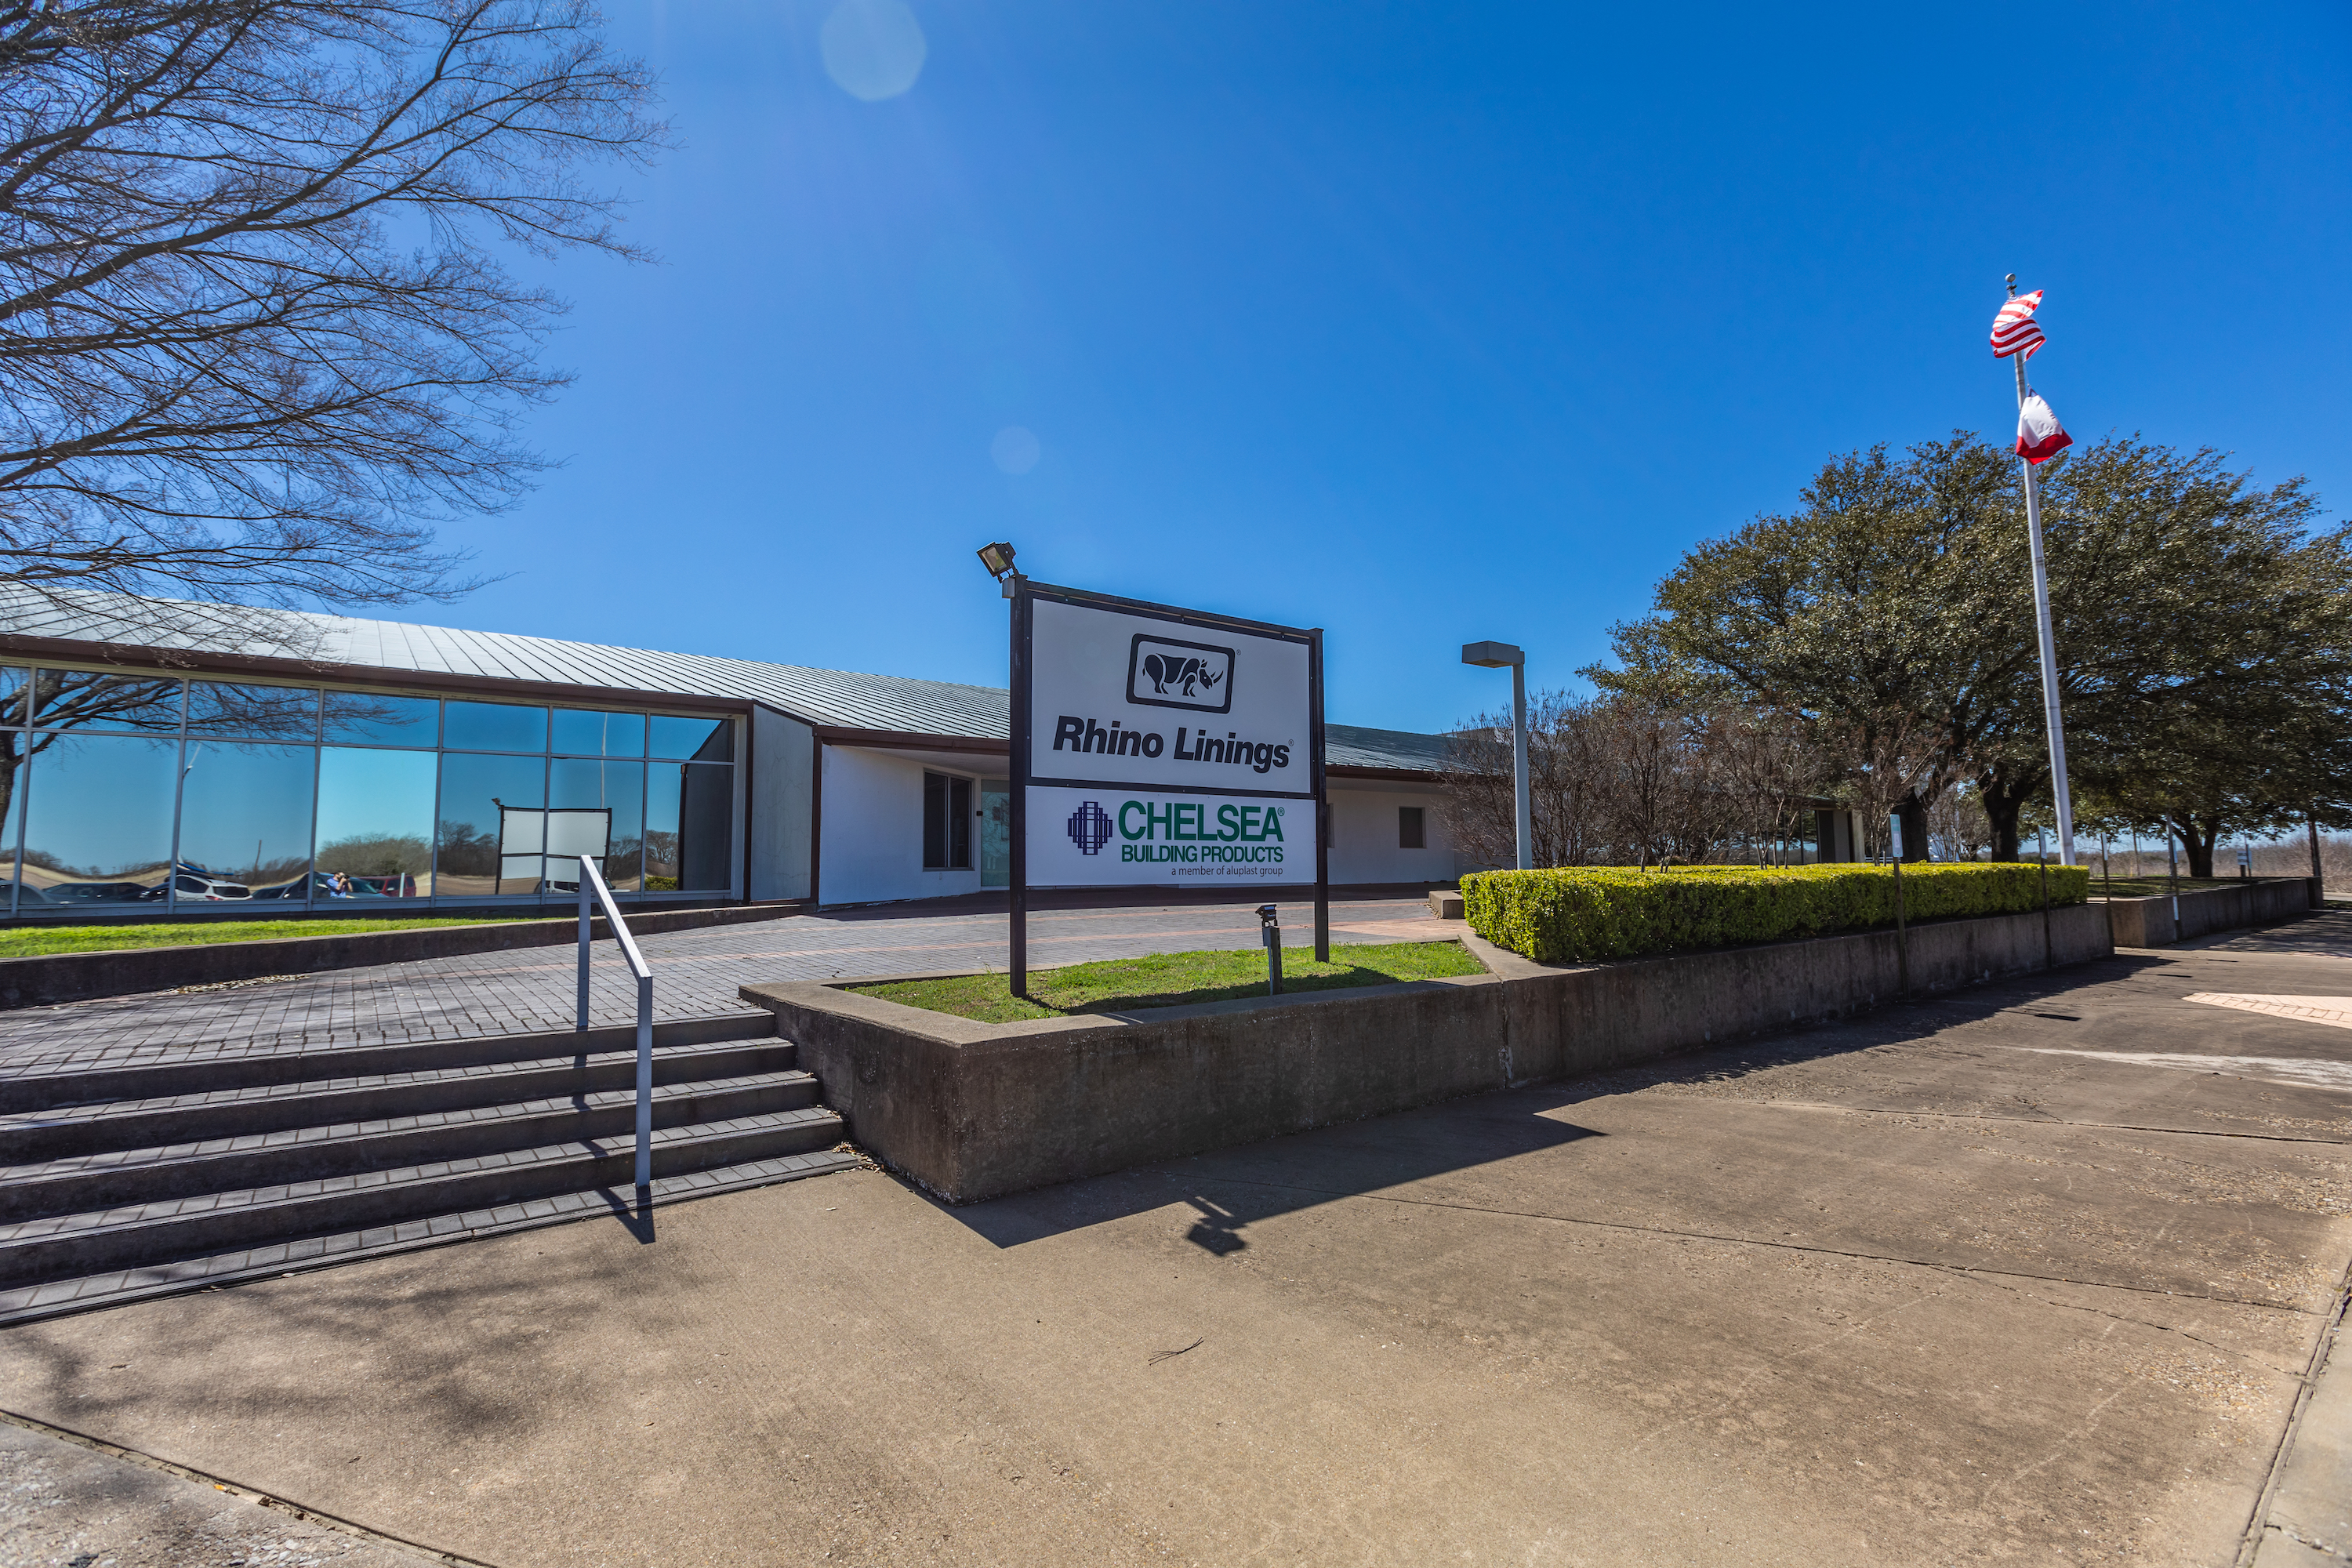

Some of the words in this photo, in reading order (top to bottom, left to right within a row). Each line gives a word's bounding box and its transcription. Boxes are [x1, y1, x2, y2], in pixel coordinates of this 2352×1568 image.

[1052, 715, 1164, 758] Rhino
[1121, 844, 1197, 862] BUILDING
[1201, 846, 1284, 862] PRODUCTS
[1171, 867, 1177, 876] a
[1178, 866, 1214, 876] member
[1216, 866, 1225, 875] of
[1226, 866, 1258, 877] aluplast
[1259, 867, 1283, 877] group
